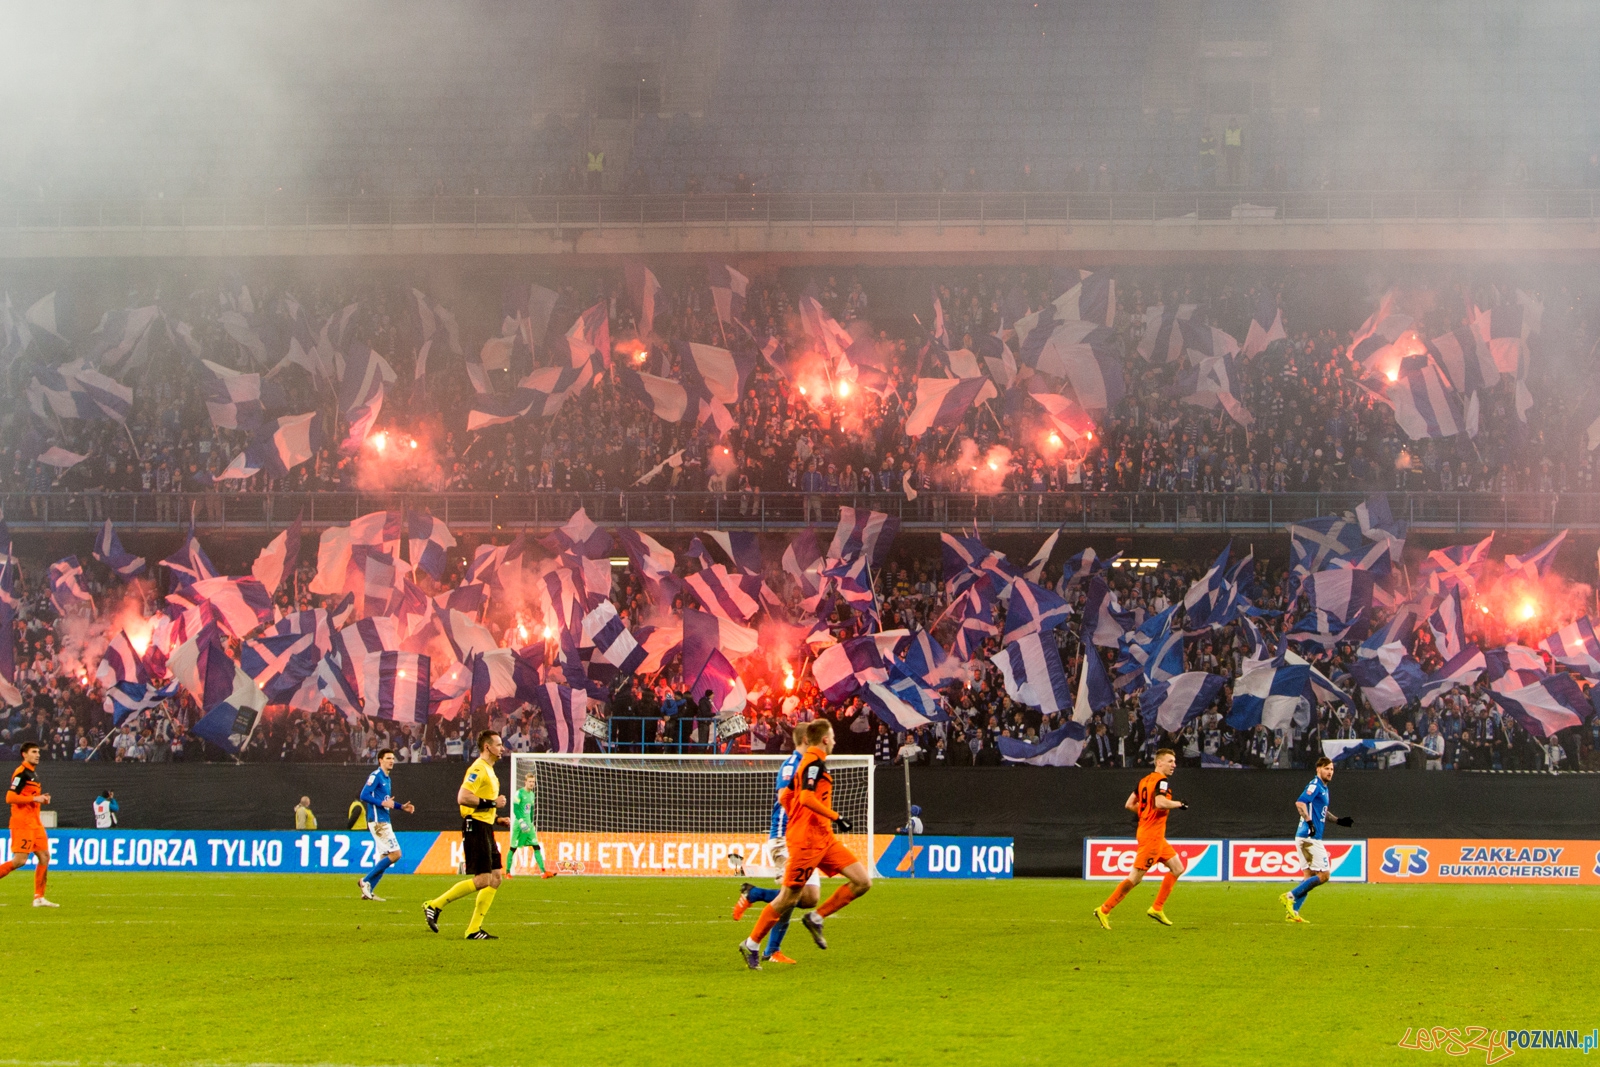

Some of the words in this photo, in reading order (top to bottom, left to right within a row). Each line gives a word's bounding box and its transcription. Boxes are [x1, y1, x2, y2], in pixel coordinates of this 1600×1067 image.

[20, 838, 32, 850] 27
[68, 837, 198, 866] KOLEJORZA
[207, 839, 283, 867] TYLKO
[295, 834, 350, 867] 112
[928, 844, 961, 872] DO
[1381, 846, 1430, 876] STS
[1460, 847, 1564, 862] ZAKŁADY
[794, 867, 814, 882] 20
[1438, 865, 1580, 877] BUKMACHERSKIE
